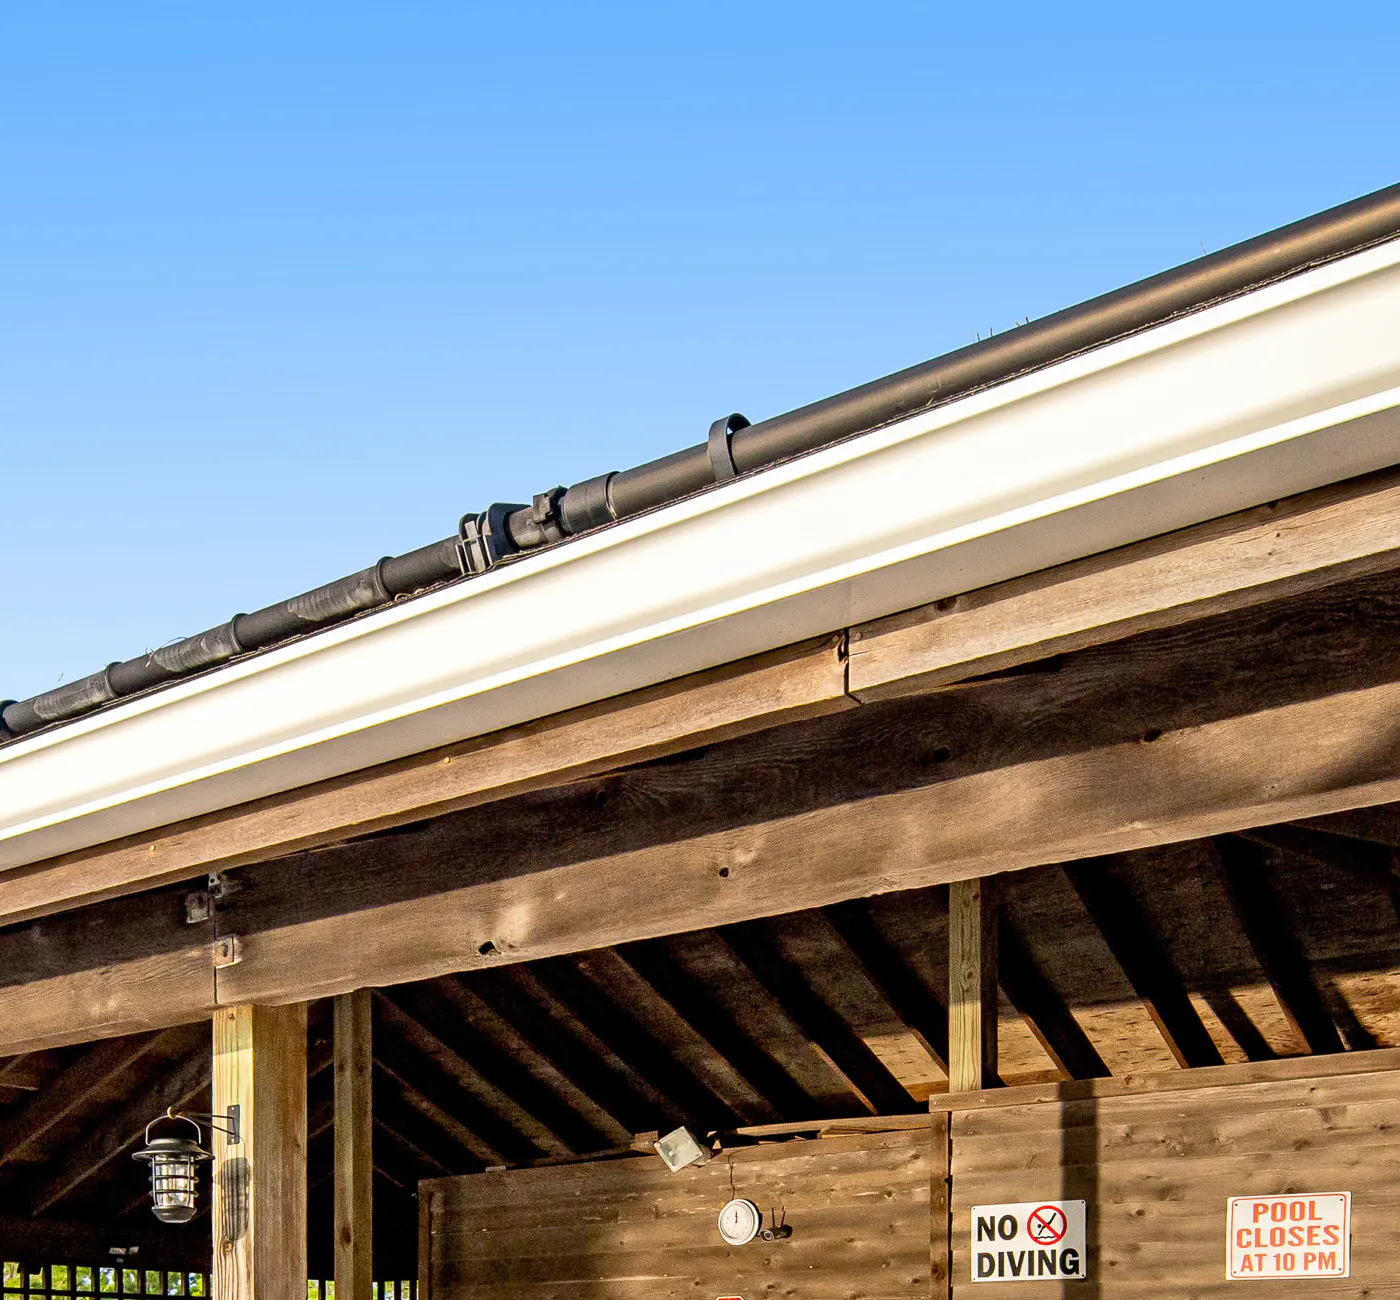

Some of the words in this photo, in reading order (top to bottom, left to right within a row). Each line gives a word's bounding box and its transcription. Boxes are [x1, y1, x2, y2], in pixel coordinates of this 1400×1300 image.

[1253, 1200, 1323, 1223] POOL
[977, 1214, 1018, 1242] NO
[1236, 1225, 1340, 1248] CLOSES
[977, 1248, 1080, 1278] DIVING
[1240, 1253, 1267, 1272] AT
[1273, 1252, 1296, 1272] 10
[1303, 1251, 1336, 1271] PM
